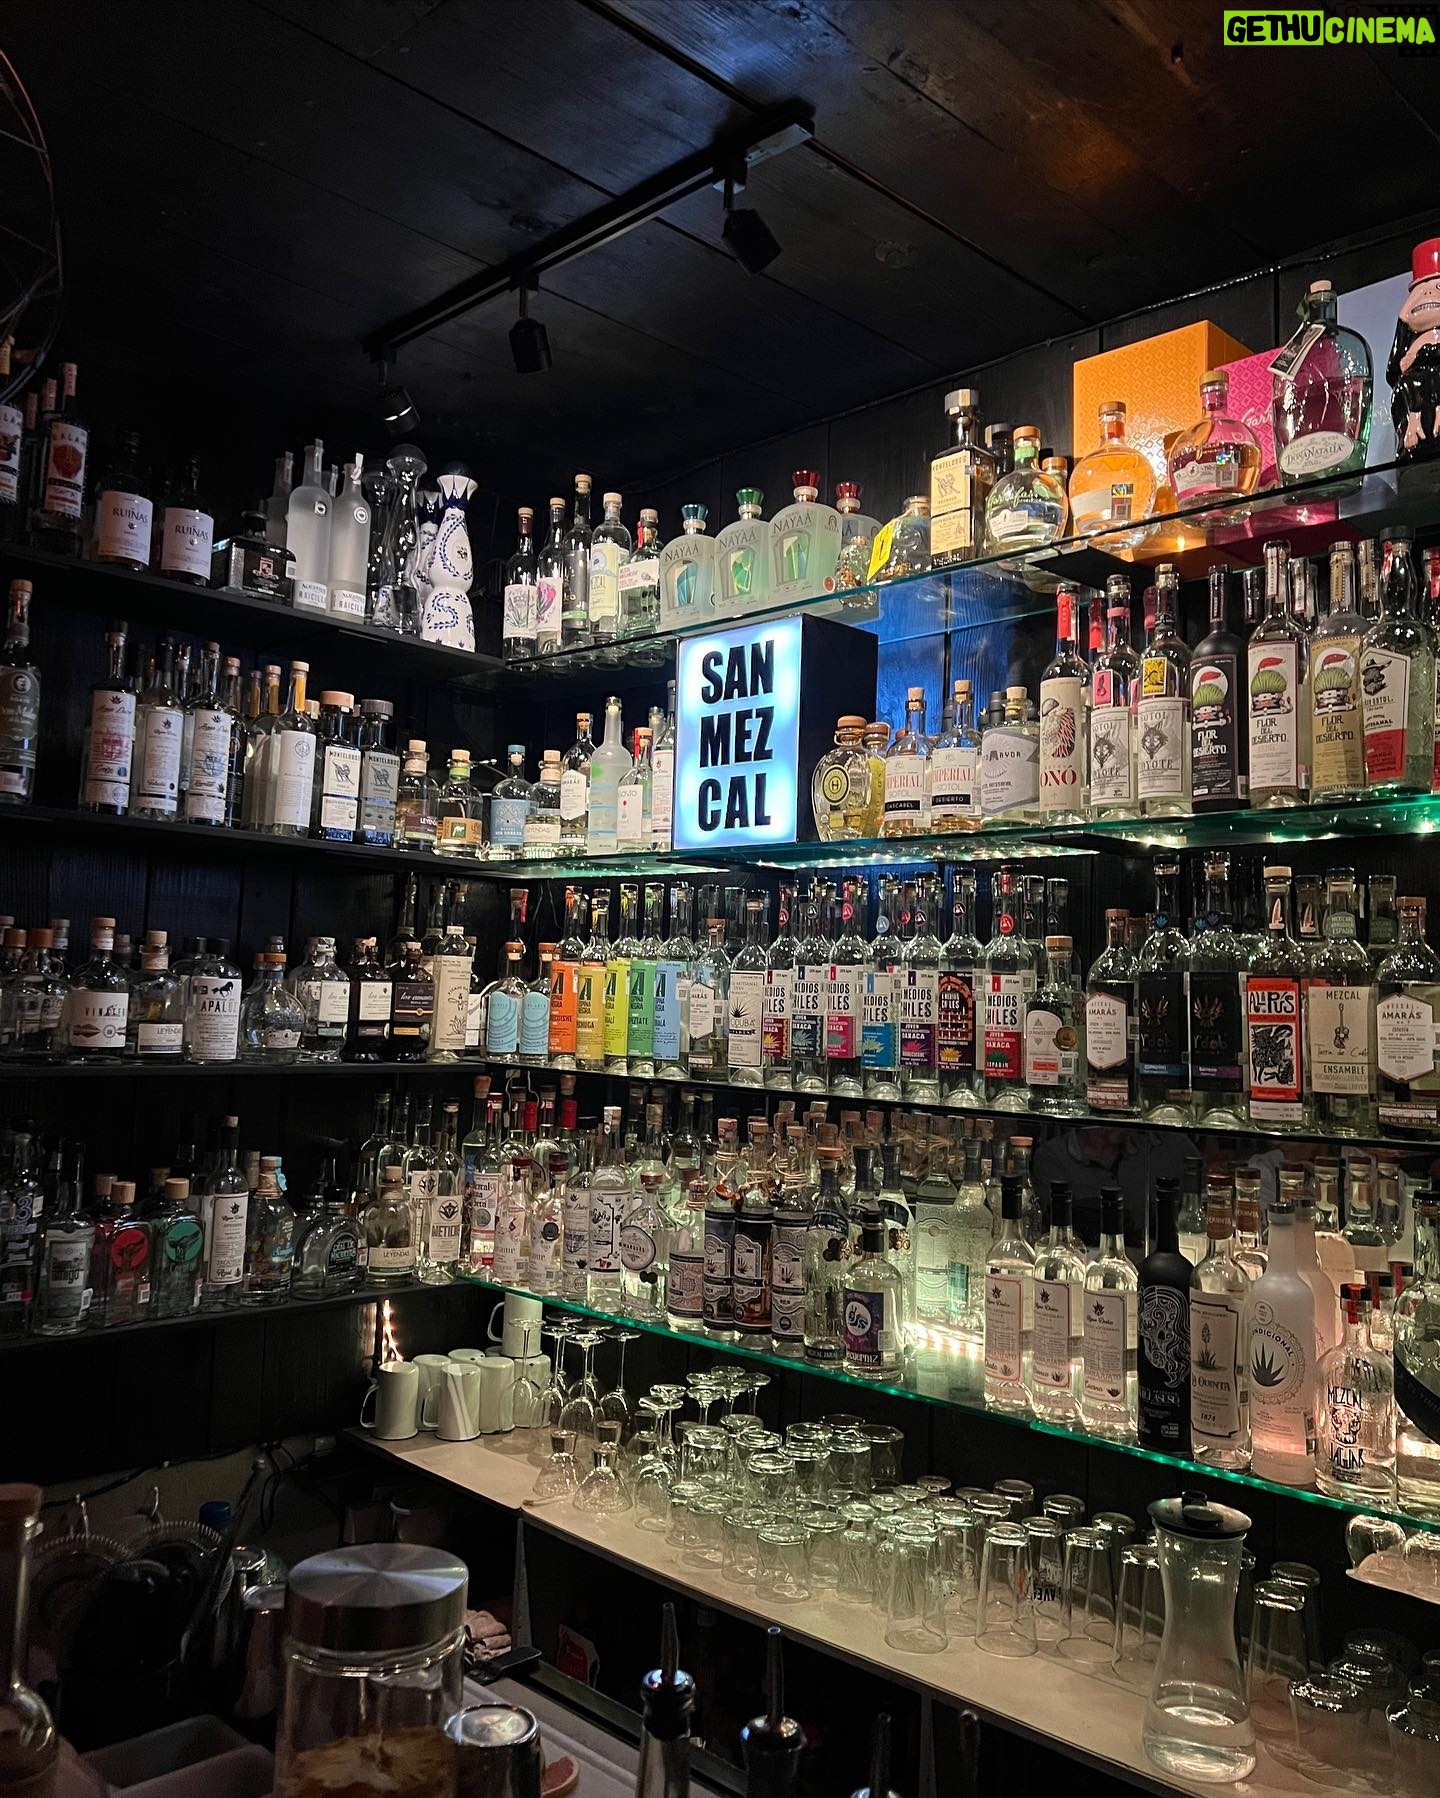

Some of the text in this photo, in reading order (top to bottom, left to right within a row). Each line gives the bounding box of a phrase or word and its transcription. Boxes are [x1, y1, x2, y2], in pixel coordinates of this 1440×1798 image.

[701, 639, 775, 704] SAN
[1256, 718, 1278, 728] FLOR
[1322, 715, 1344, 726] FLOR
[699, 705, 775, 769] MEZ
[1198, 730, 1218, 741] FLOR
[698, 772, 771, 832] CAL
[904, 989, 932, 1000] MEDIOS
[1326, 990, 1361, 1000] MEZCAL
[987, 995, 1017, 1007] MEDIOS
[1382, 1010, 1422, 1020] AMARÁS
[1323, 1065, 1365, 1074] ENSAMBLE
[16, 1196, 32, 1222] 3
